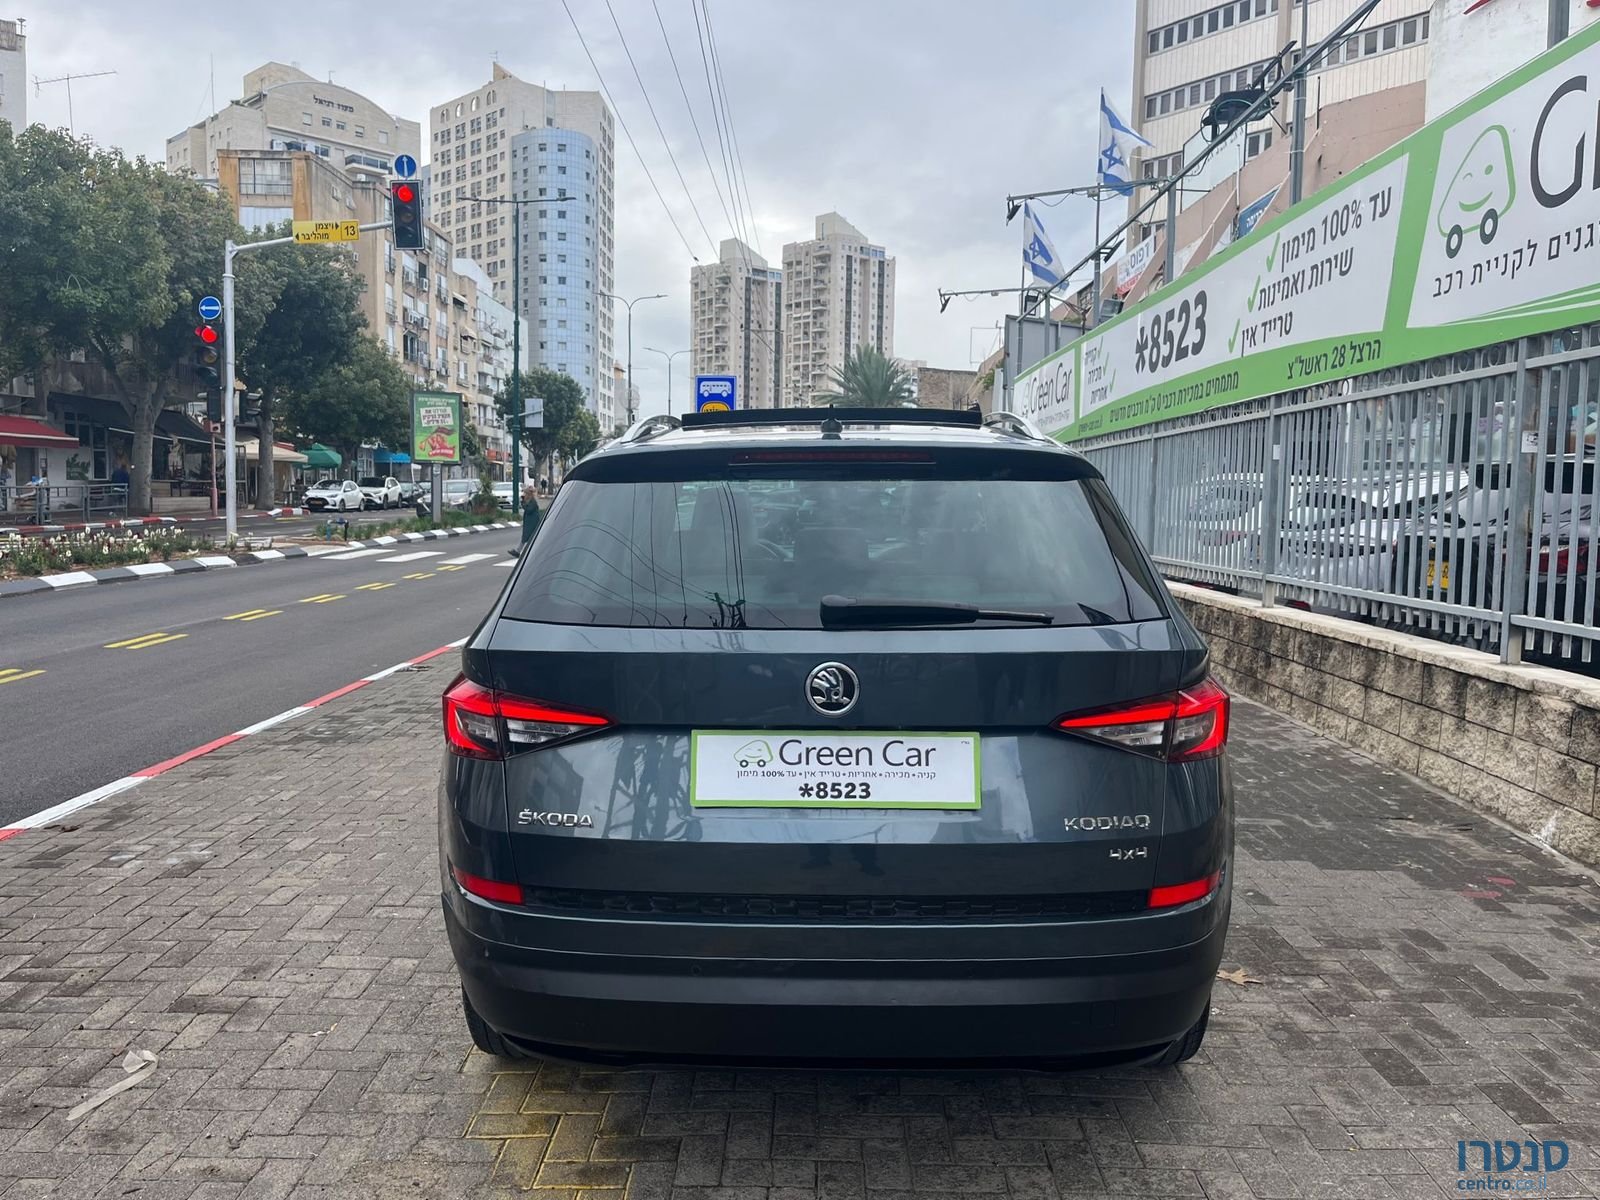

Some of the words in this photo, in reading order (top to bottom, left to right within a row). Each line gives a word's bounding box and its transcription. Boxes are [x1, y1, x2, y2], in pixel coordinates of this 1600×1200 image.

[313, 94, 335, 108] דניאל
[1369, 186, 1392, 222] עד
[315, 222, 334, 232] ויצמן
[344, 225, 356, 237] 13
[1321, 199, 1363, 245] 100%
[301, 231, 329, 240] מוהליבר
[1548, 221, 1600, 261] גנים
[1130, 242, 1150, 268] דפוס
[1281, 227, 1316, 273] מימון
[1471, 239, 1538, 286] לקניית
[1308, 247, 1354, 290] שירות
[1258, 269, 1305, 311] ואמינות
[1432, 270, 1464, 297] רכב
[1261, 311, 1293, 343] טרייד
[1240, 325, 1258, 358] אין
[1350, 339, 1381, 365] הרצל
[1330, 344, 1346, 369] 28
[1030, 376, 1053, 414] Green
[1055, 362, 1073, 405] Car
[1088, 366, 1102, 385] מכירה
[1205, 371, 1239, 397] מתמחים
[1162, 392, 1176, 410] רכבי
[1177, 382, 1204, 406] במכירת
[779, 739, 873, 767] Green
[882, 740, 937, 767] Car
[804, 771, 816, 779] אין
[917, 771, 936, 780] קניה
[518, 808, 594, 828] ŠKODA
[1063, 814, 1151, 831] KODIAQ
